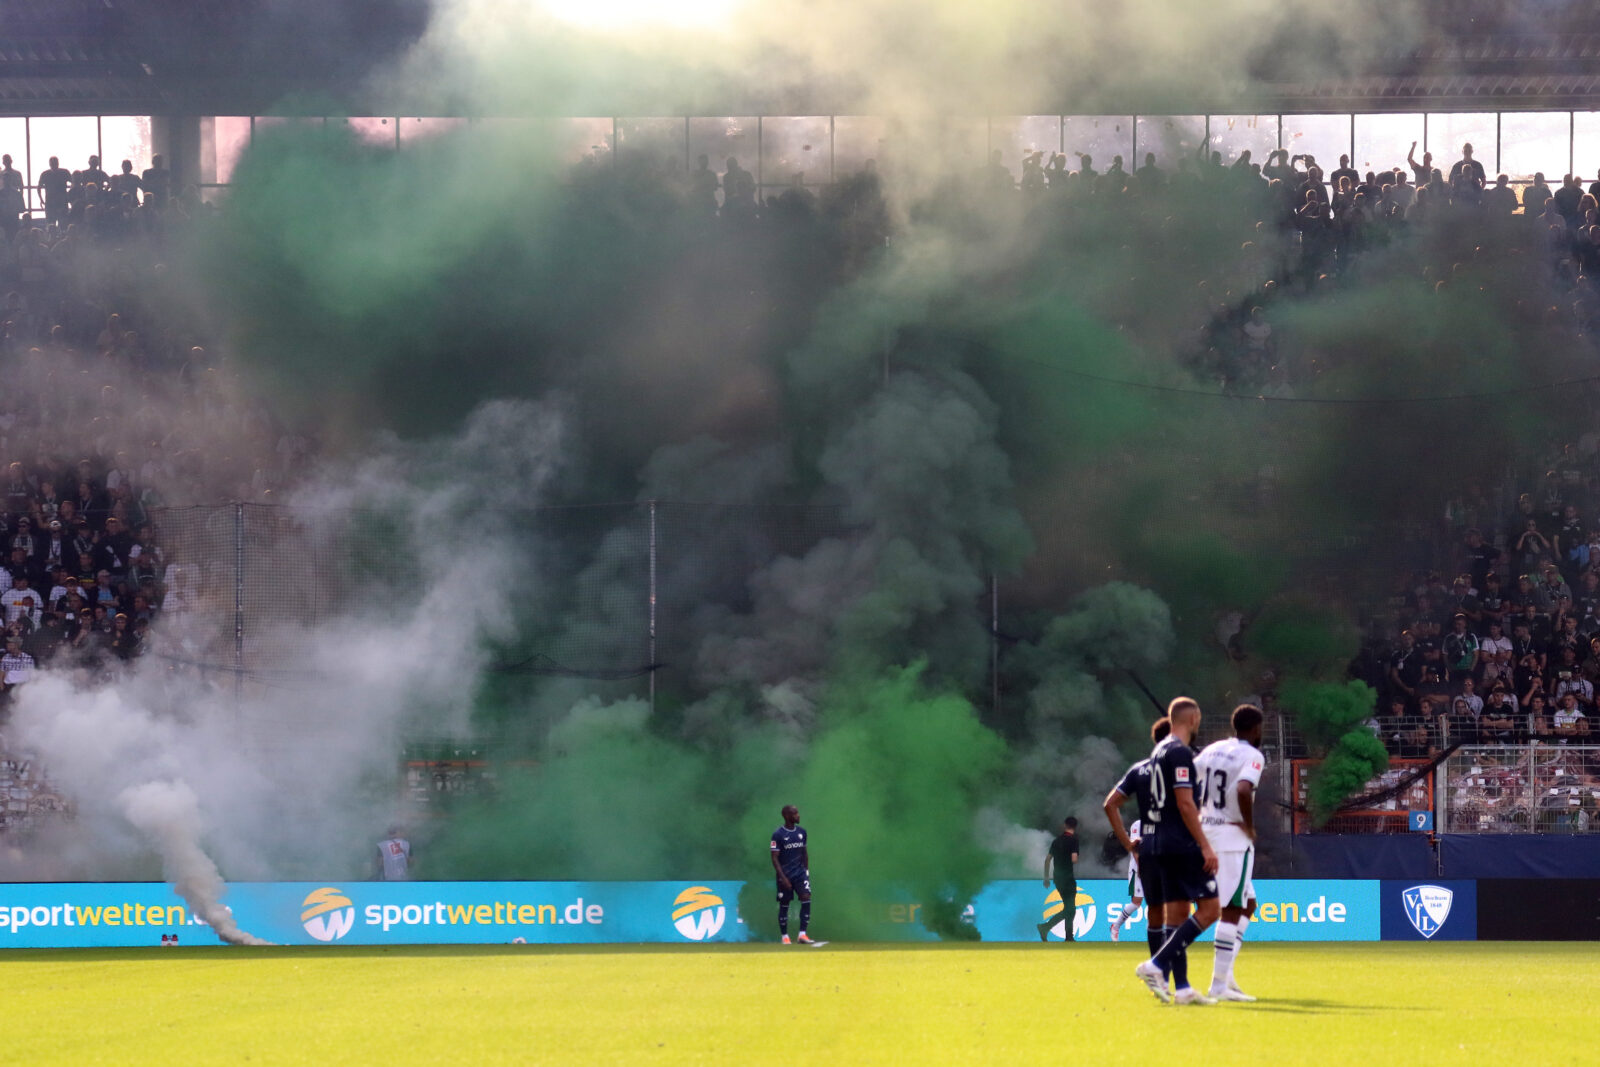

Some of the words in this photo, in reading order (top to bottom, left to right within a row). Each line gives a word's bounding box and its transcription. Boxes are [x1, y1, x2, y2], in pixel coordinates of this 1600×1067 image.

[1202, 767, 1227, 810] 13
[1416, 813, 1427, 829] 9
[0, 902, 233, 933] sportwetten.
[365, 898, 604, 932] sportwetten.de
